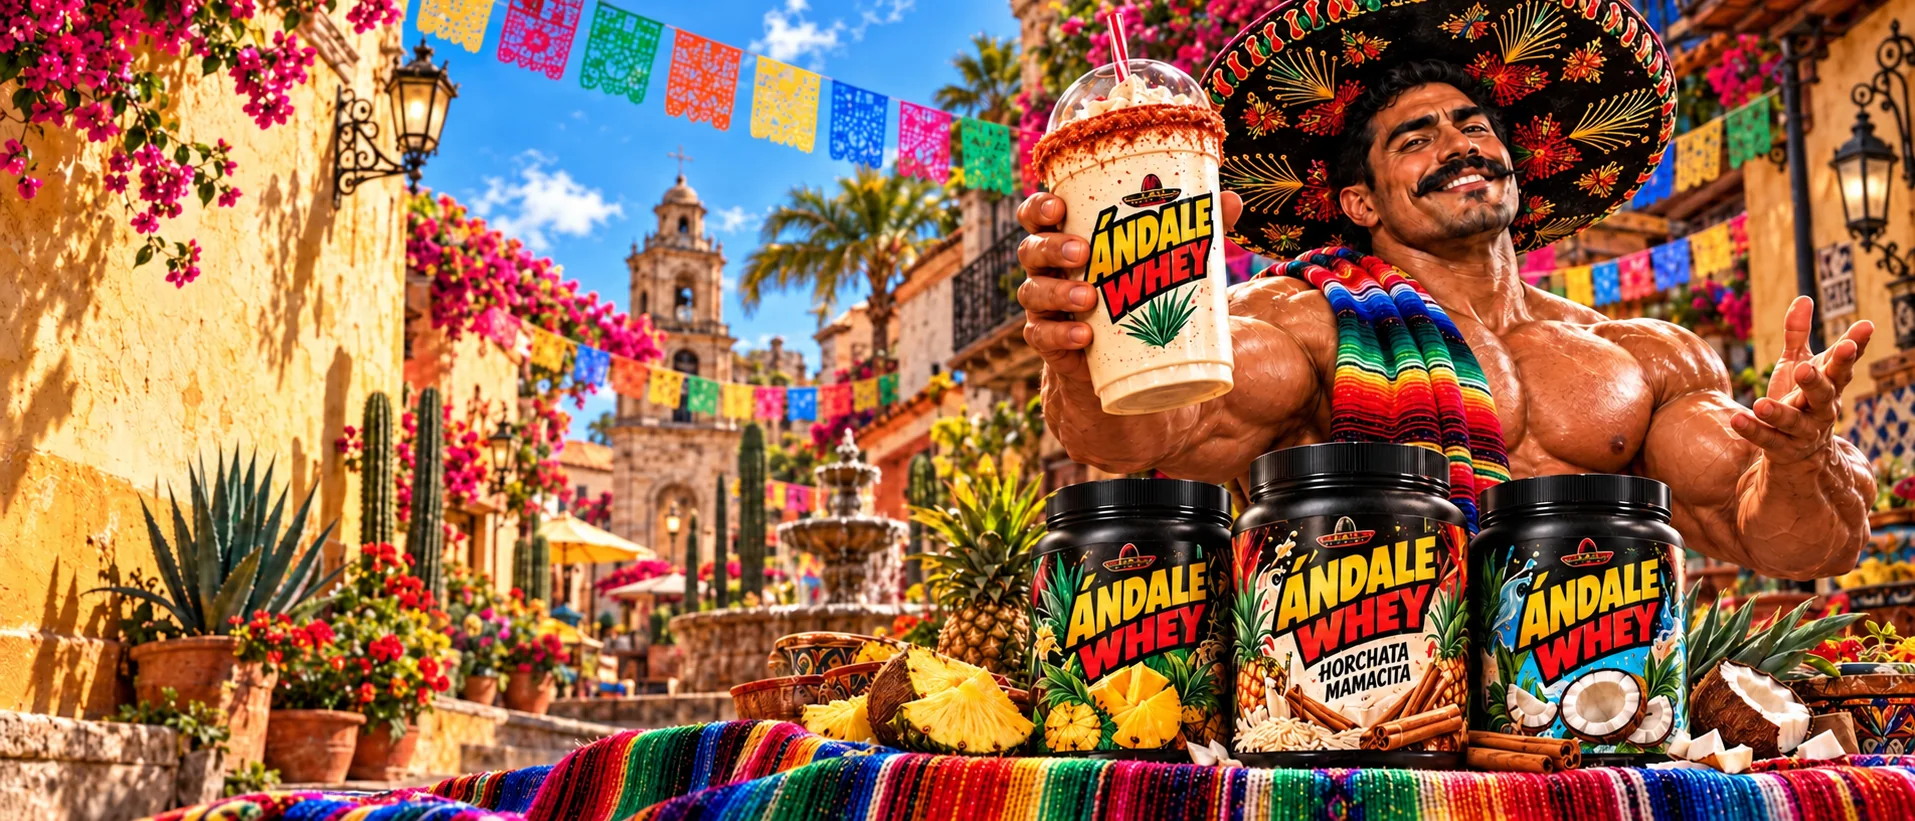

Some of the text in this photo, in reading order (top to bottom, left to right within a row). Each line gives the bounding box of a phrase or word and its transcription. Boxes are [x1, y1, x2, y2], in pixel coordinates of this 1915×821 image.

[1087, 198, 1212, 284] ÁNDALE
[1103, 239, 1209, 318] WHEY
[1065, 562, 1207, 649] ÁNDALE
[1276, 536, 1436, 631] ÁNDALE
[1518, 558, 1660, 648] ÁNDALE
[1078, 604, 1206, 681] WHEY
[1297, 584, 1431, 664] WHEY
[1318, 642, 1409, 683] HORCHATA
[1535, 602, 1659, 682] WHEY
[1324, 664, 1411, 702] MAMACITA
